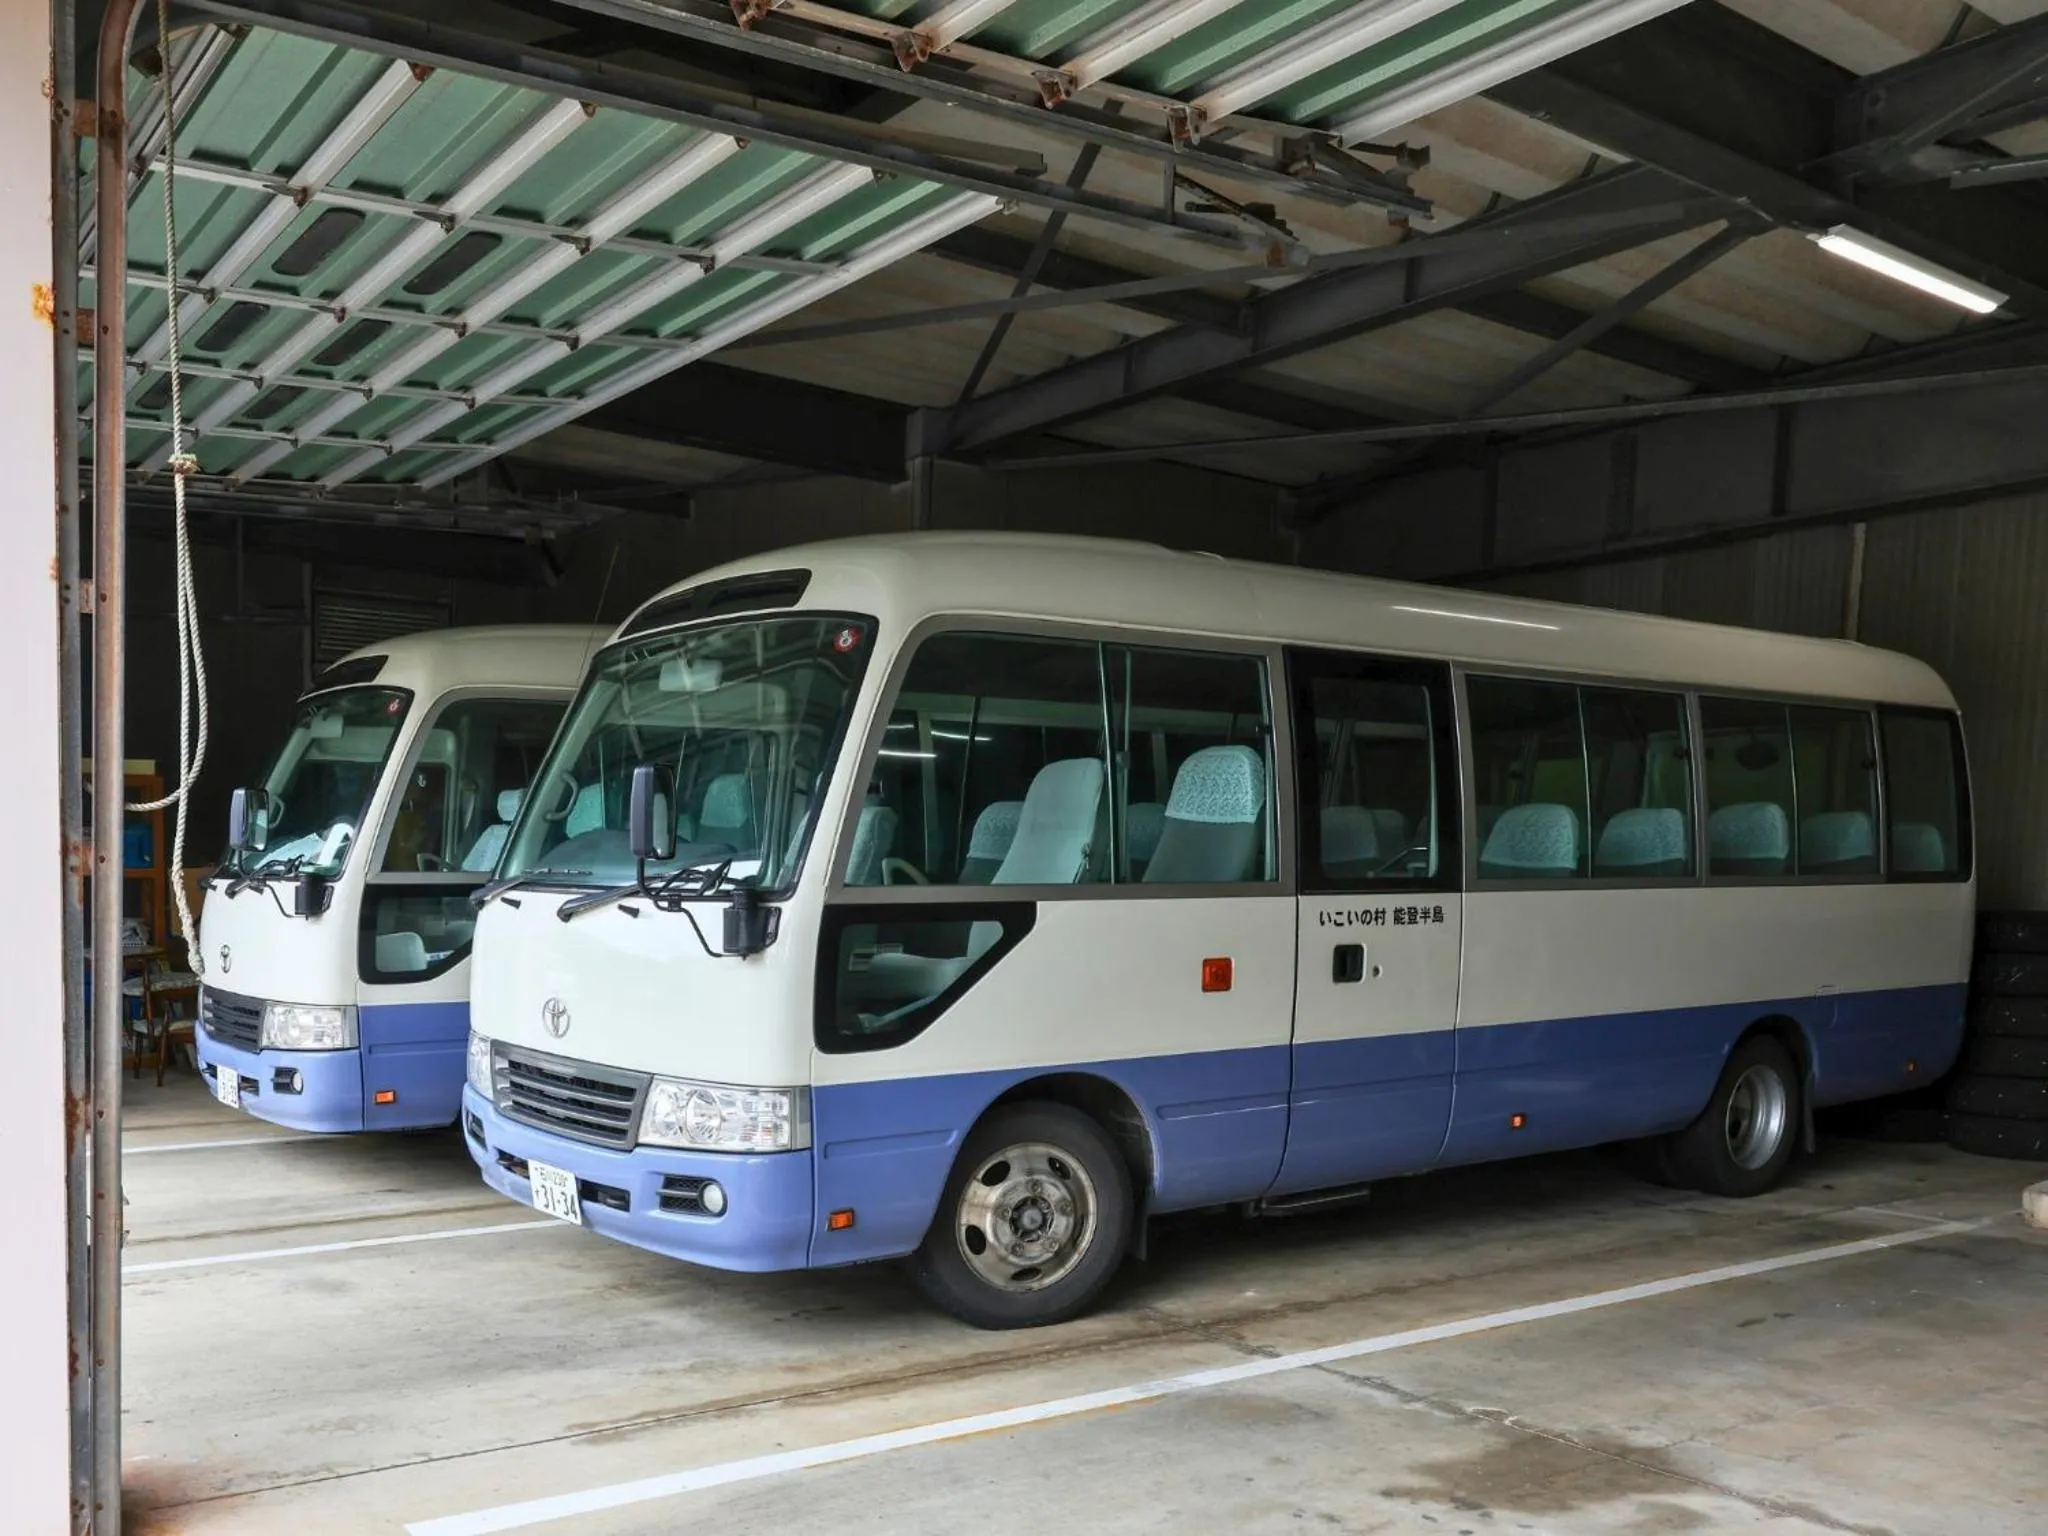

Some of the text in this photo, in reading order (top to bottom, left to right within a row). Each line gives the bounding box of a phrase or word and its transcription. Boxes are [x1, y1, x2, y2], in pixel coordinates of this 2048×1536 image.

[1319, 906, 1444, 926] いこいの村 能登半島
[542, 1185, 577, 1219] 31-34
